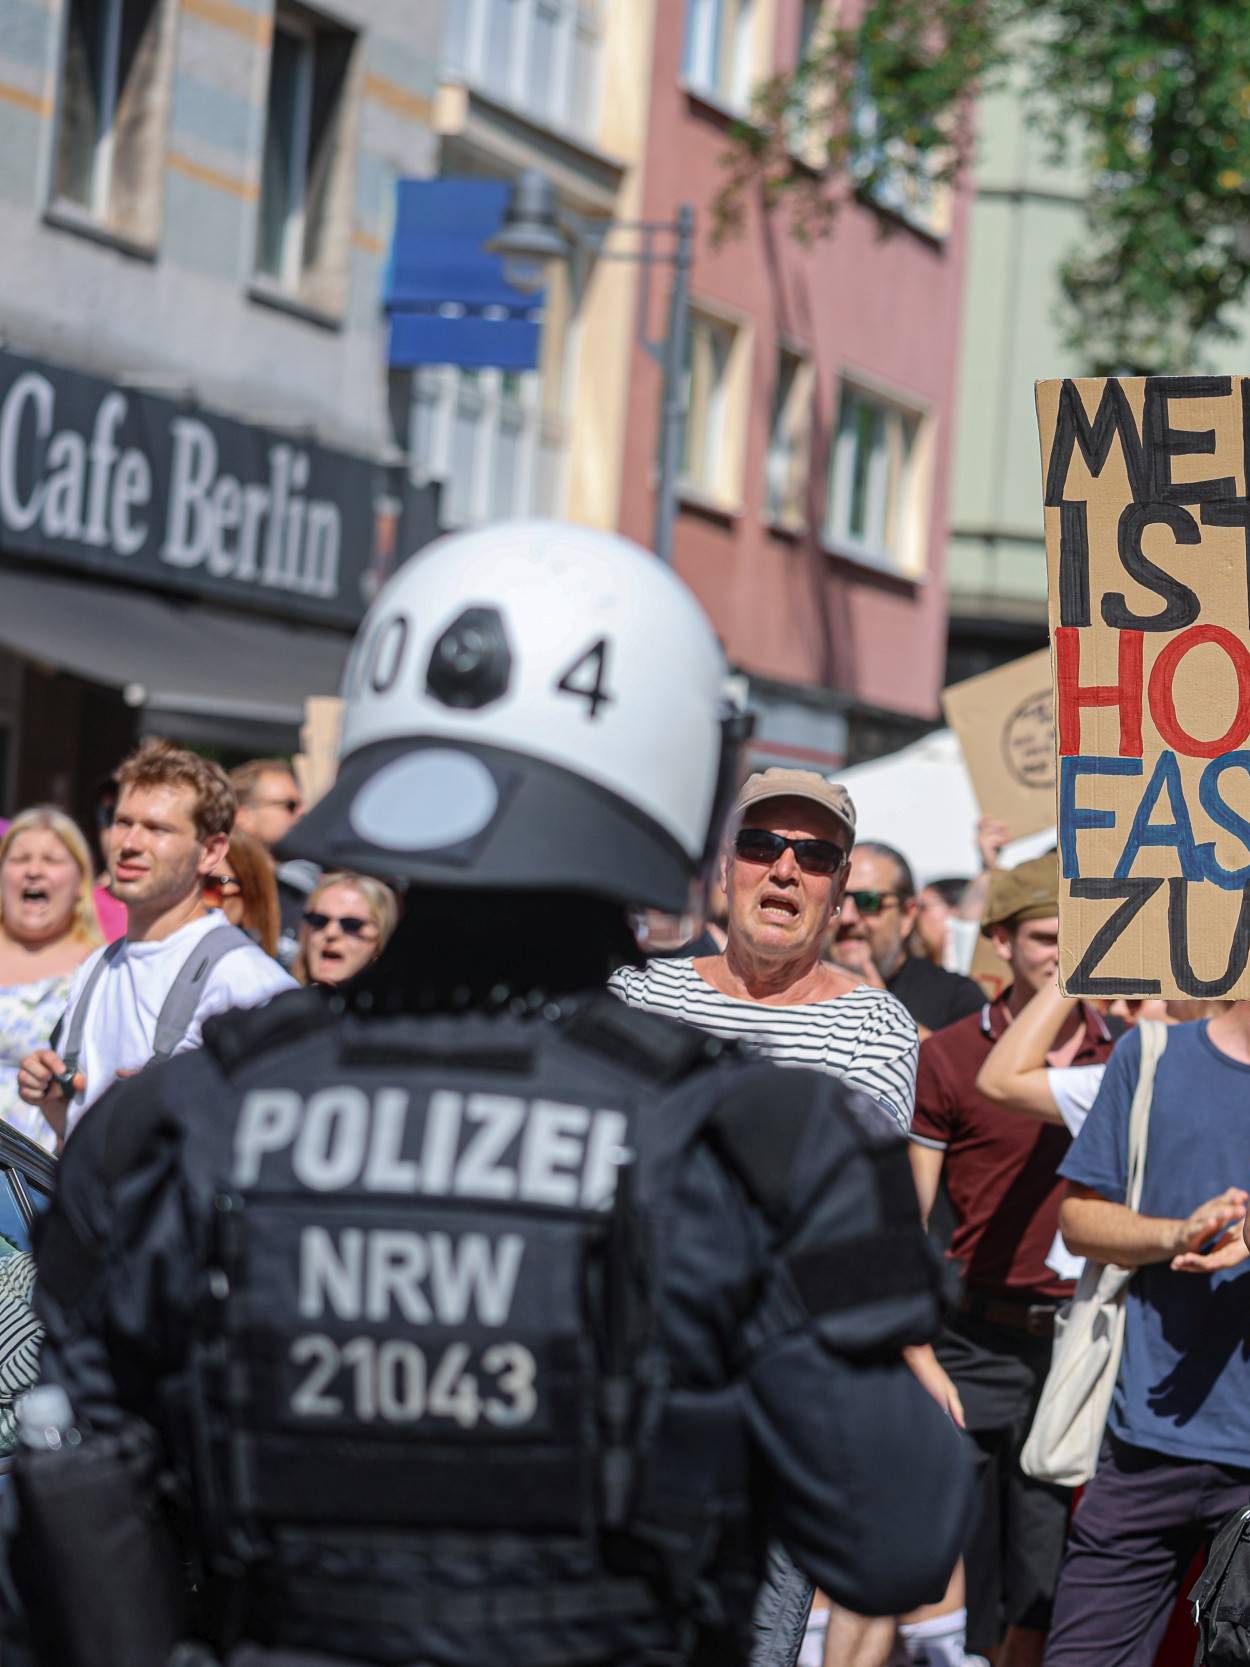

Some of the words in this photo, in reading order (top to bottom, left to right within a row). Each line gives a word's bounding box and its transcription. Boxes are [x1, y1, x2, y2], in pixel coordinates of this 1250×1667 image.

[0, 373, 151, 555] Cafe
[161, 415, 341, 599] Berlin
[554, 636, 617, 720] 4
[231, 1085, 629, 1213] POLIZEI
[301, 1226, 525, 1326] NRW
[290, 1333, 538, 1429] 21043
